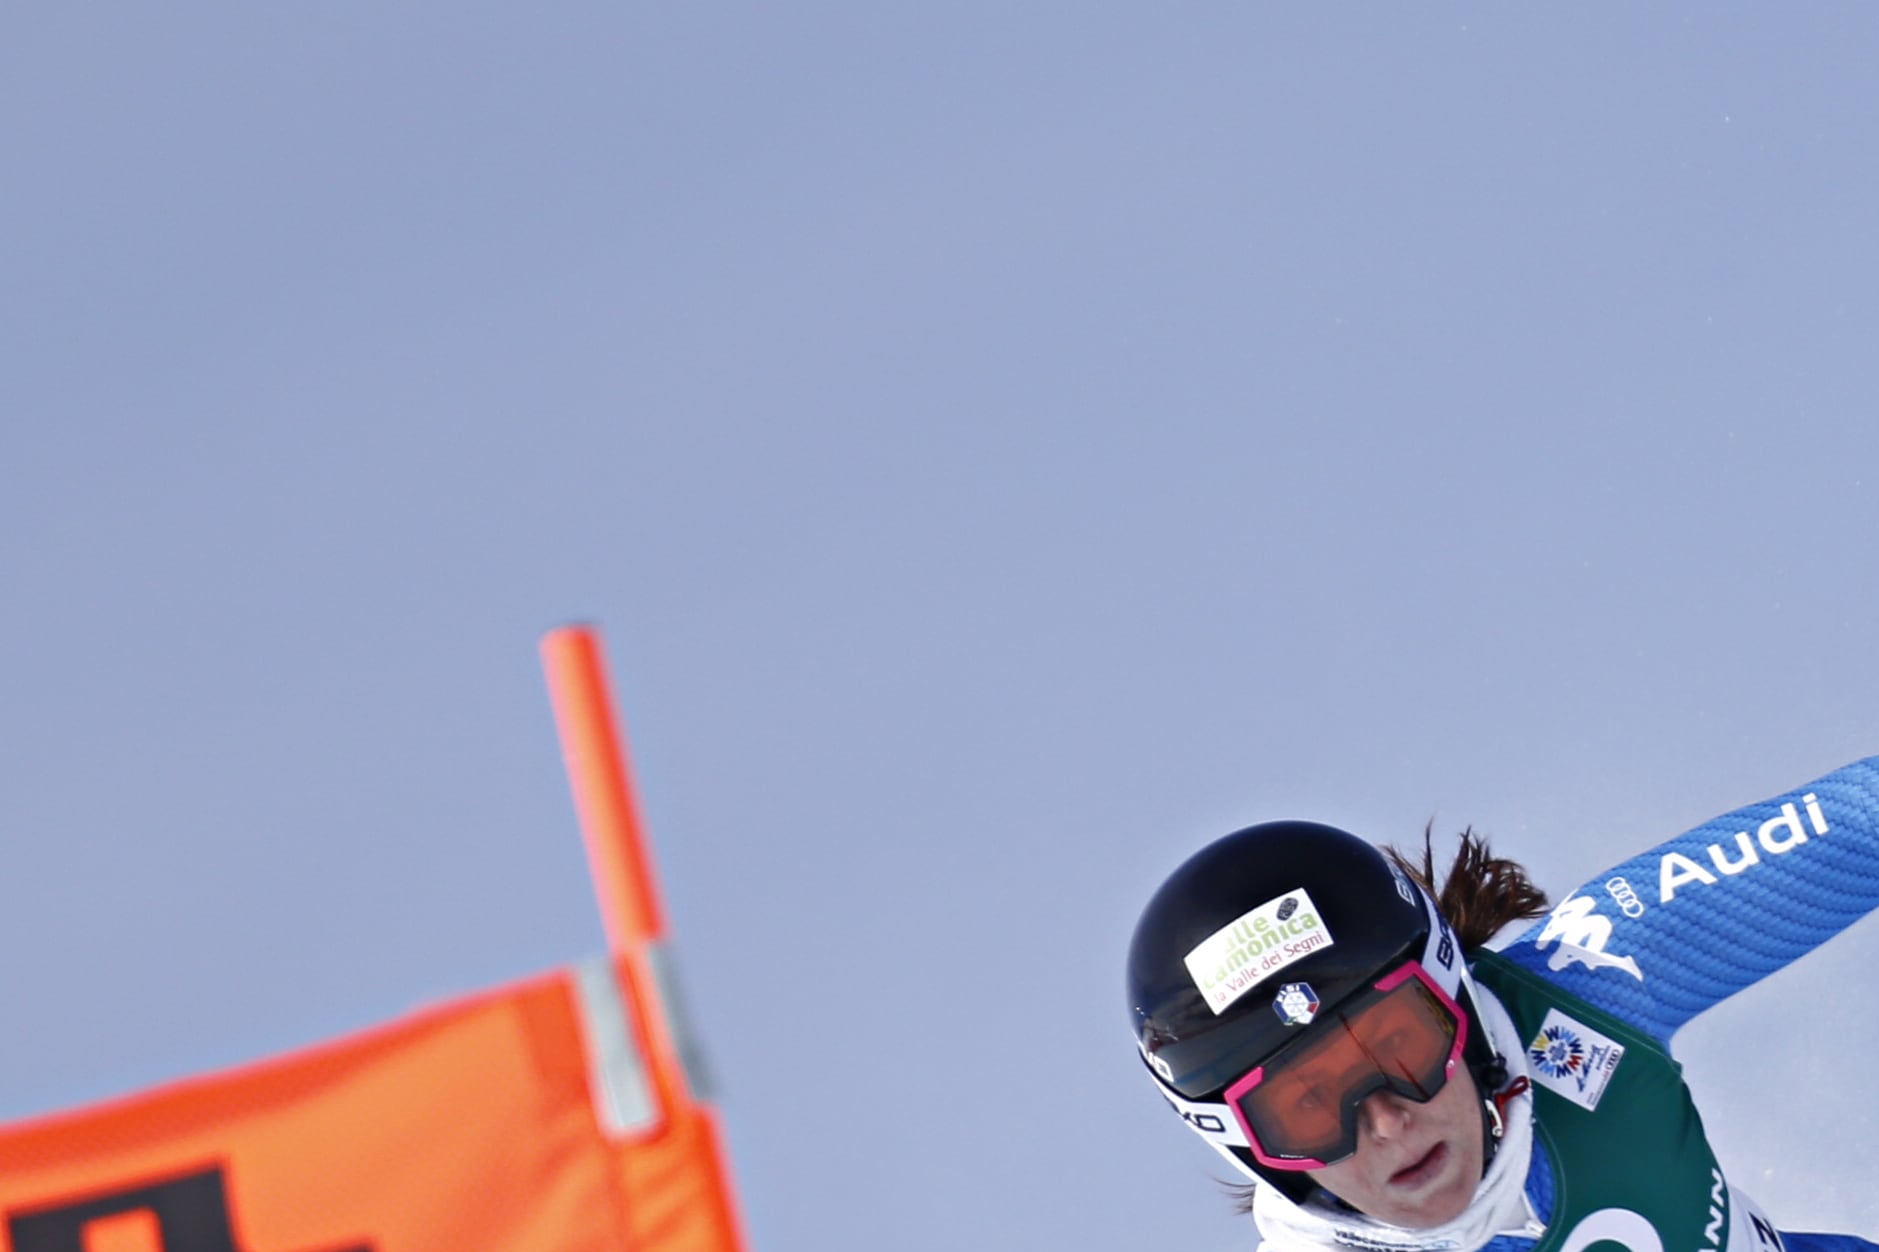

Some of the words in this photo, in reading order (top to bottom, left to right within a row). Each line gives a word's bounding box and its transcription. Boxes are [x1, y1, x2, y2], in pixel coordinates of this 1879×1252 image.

[1660, 792, 1830, 903] Audi
[1225, 966, 1260, 993] Valle
[1261, 950, 1283, 972] dei
[1283, 930, 1326, 959] Segni
